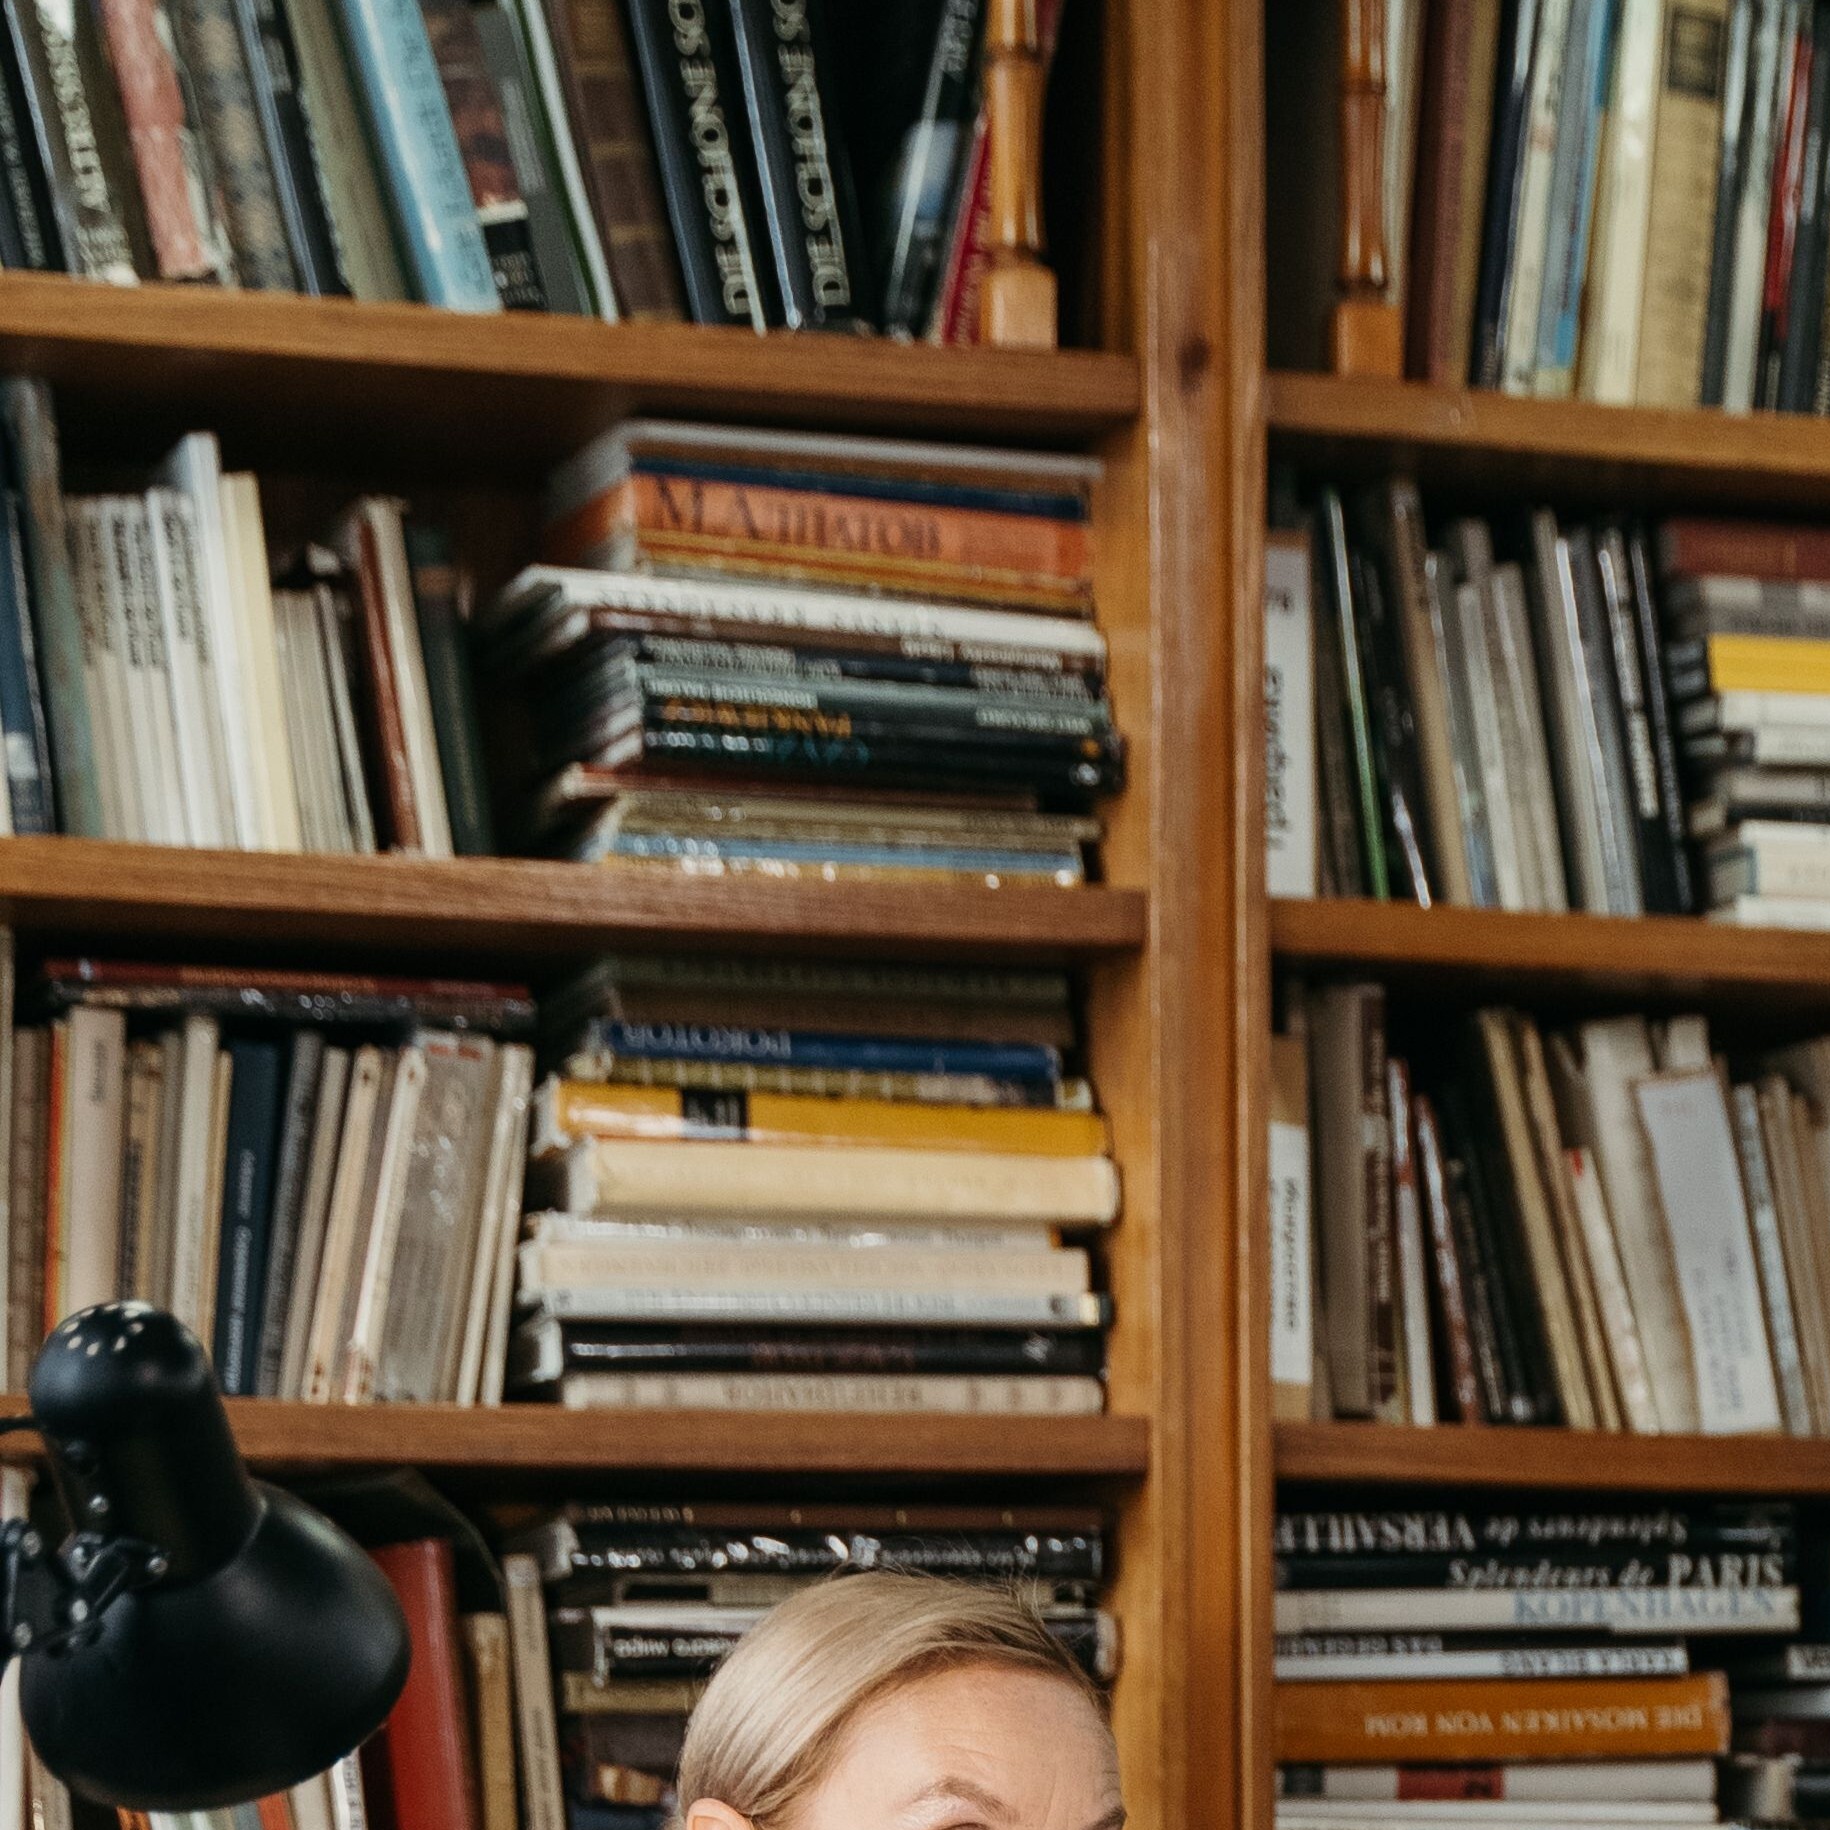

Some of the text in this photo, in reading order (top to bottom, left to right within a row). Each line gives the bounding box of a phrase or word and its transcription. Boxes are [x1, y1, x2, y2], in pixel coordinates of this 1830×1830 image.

[1485, 1516, 1518, 1547] de
[1527, 1511, 1687, 1546] Splendeurs
[1446, 1552, 1786, 1588] Splendeurs de PARIS
[1514, 1588, 1778, 1622] KOPENHAGEN
[1364, 1703, 1706, 1741] DIE MOSAIKEN VON ROM
